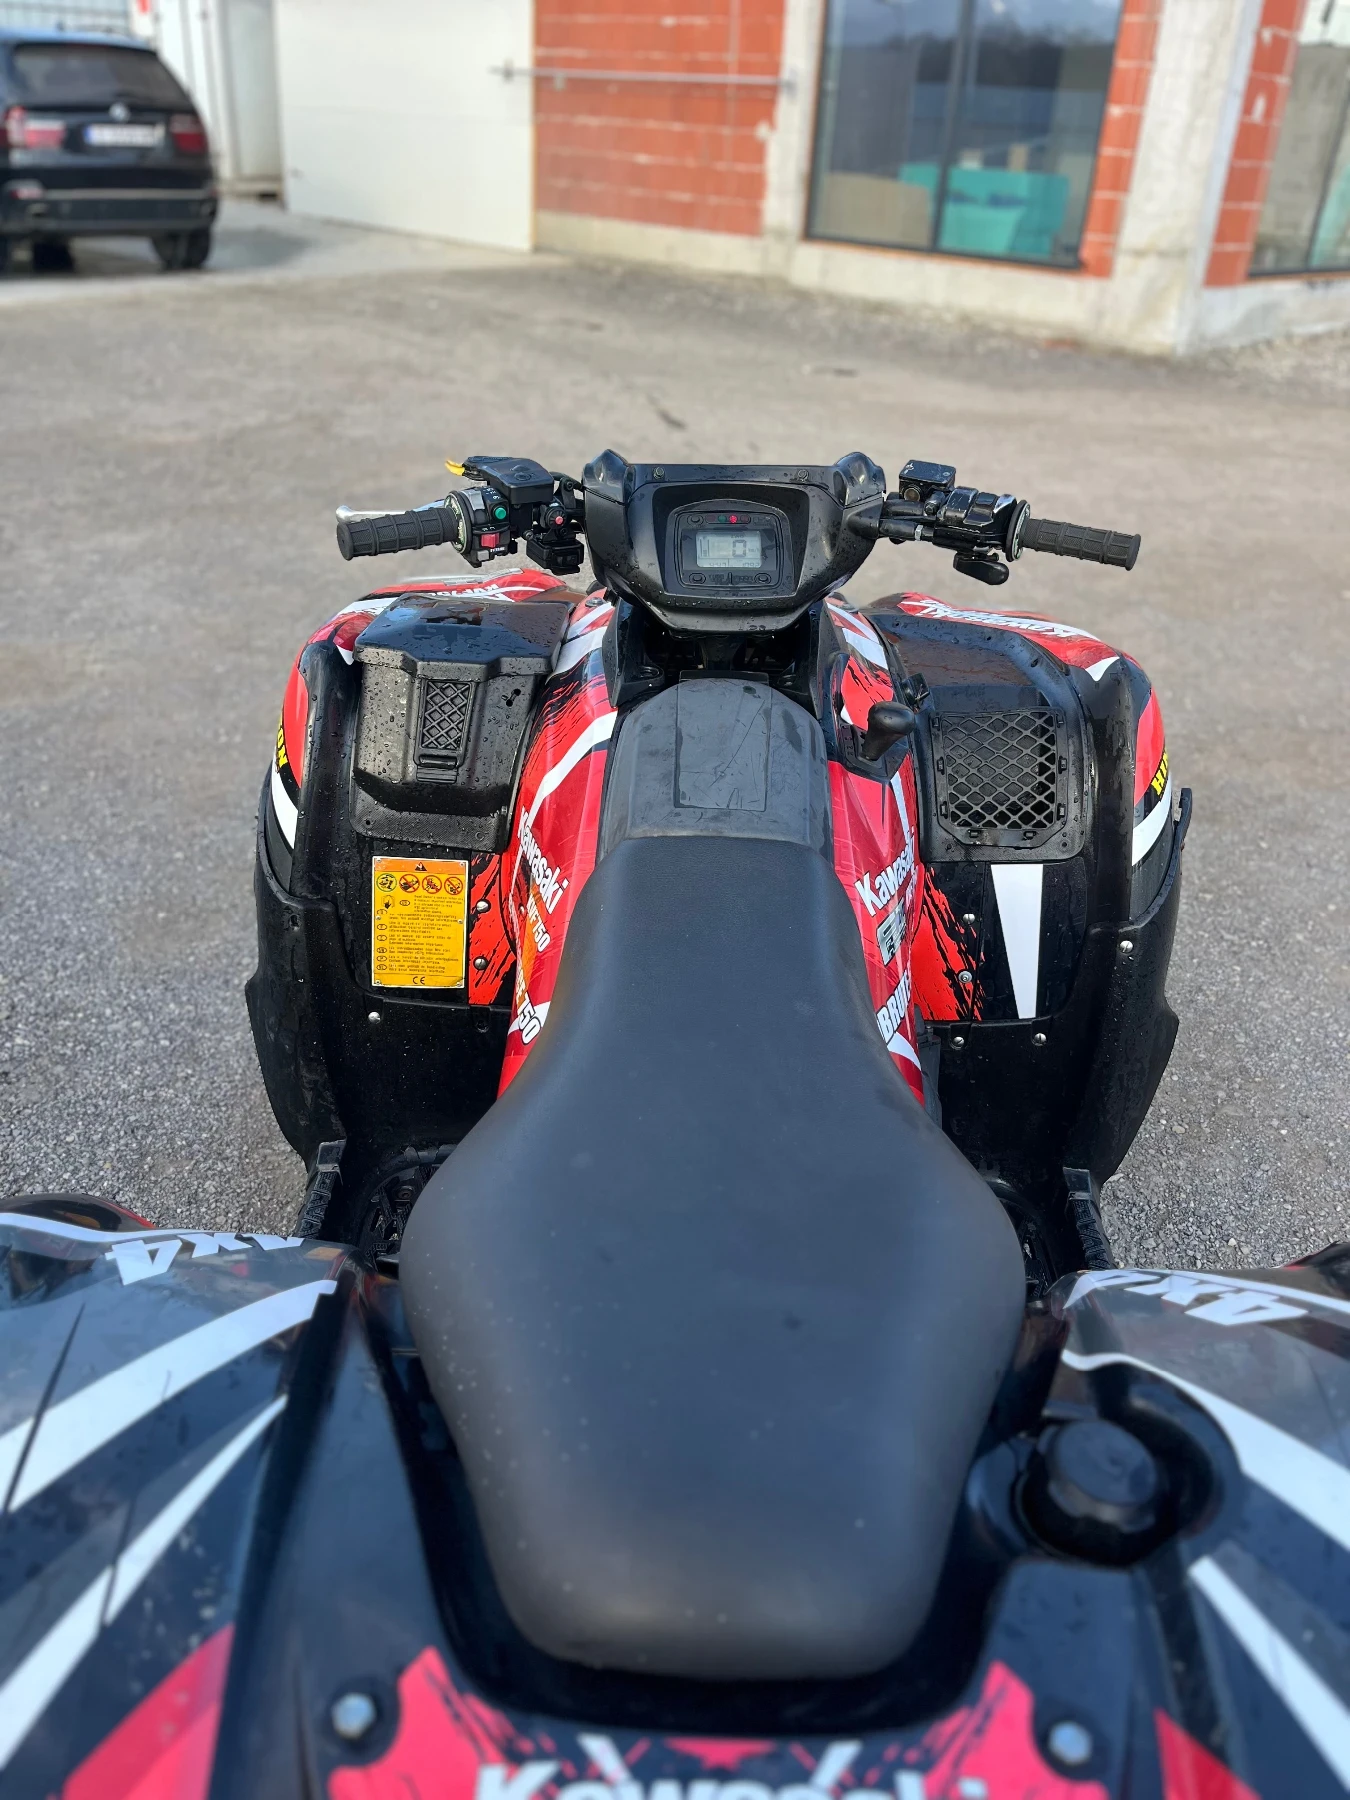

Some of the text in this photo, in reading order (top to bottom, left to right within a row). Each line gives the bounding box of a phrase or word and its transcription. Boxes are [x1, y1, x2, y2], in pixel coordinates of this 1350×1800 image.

[517, 805, 570, 915] Kawasaki
[854, 826, 915, 917] Kawasaki
[412, 975, 426, 985] CE
[516, 991, 543, 1046] 750
